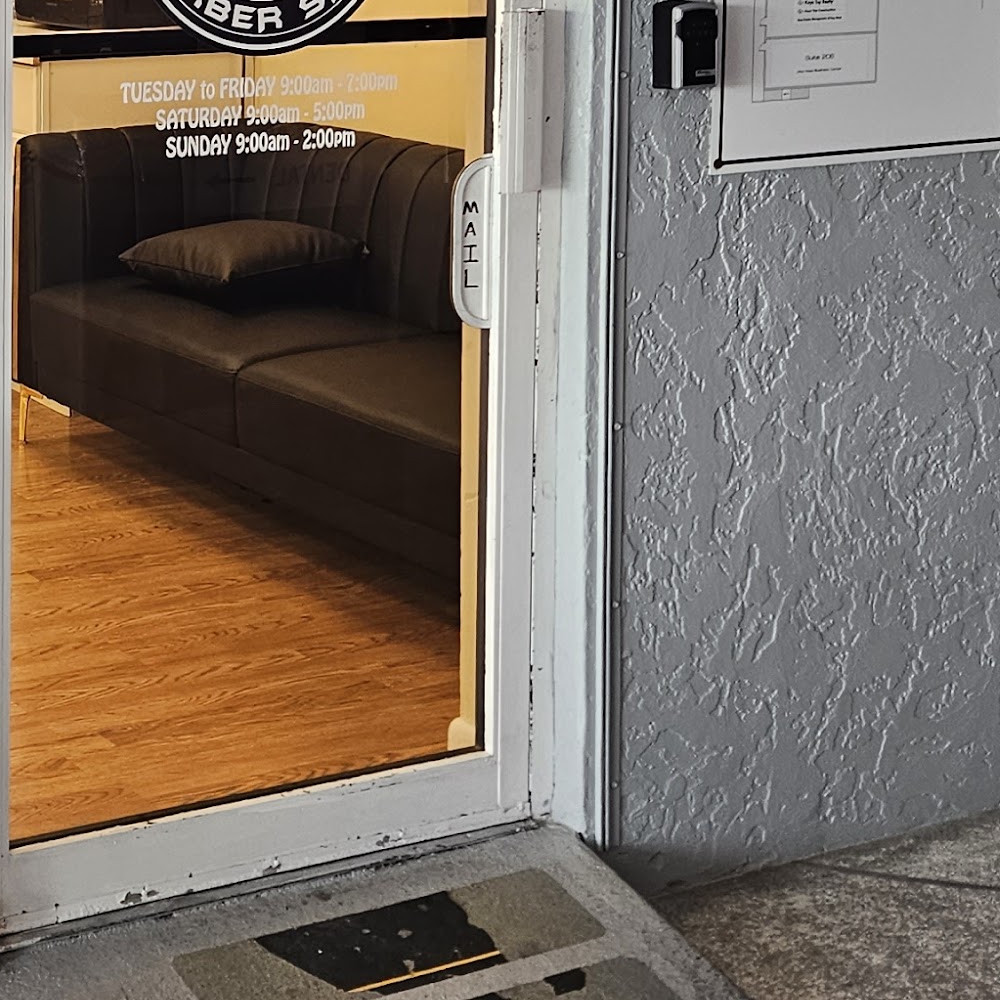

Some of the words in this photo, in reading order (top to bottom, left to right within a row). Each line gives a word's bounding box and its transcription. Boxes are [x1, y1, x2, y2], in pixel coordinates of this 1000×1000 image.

[120, 80, 196, 104] TUESDAY
[200, 83, 215, 99] to
[219, 76, 277, 99] FRIDAY
[280, 75, 334, 95] 9:00am
[155, 106, 243, 131] SATURDAY
[246, 104, 300, 126] 9:00am
[313, 100, 365, 121] 5:00pm
[165, 134, 233, 158] SUNDAY
[235, 131, 291, 154] 9:00am
[302, 127, 356, 150] 2:00pm
[462, 201, 479, 288] MAIL
